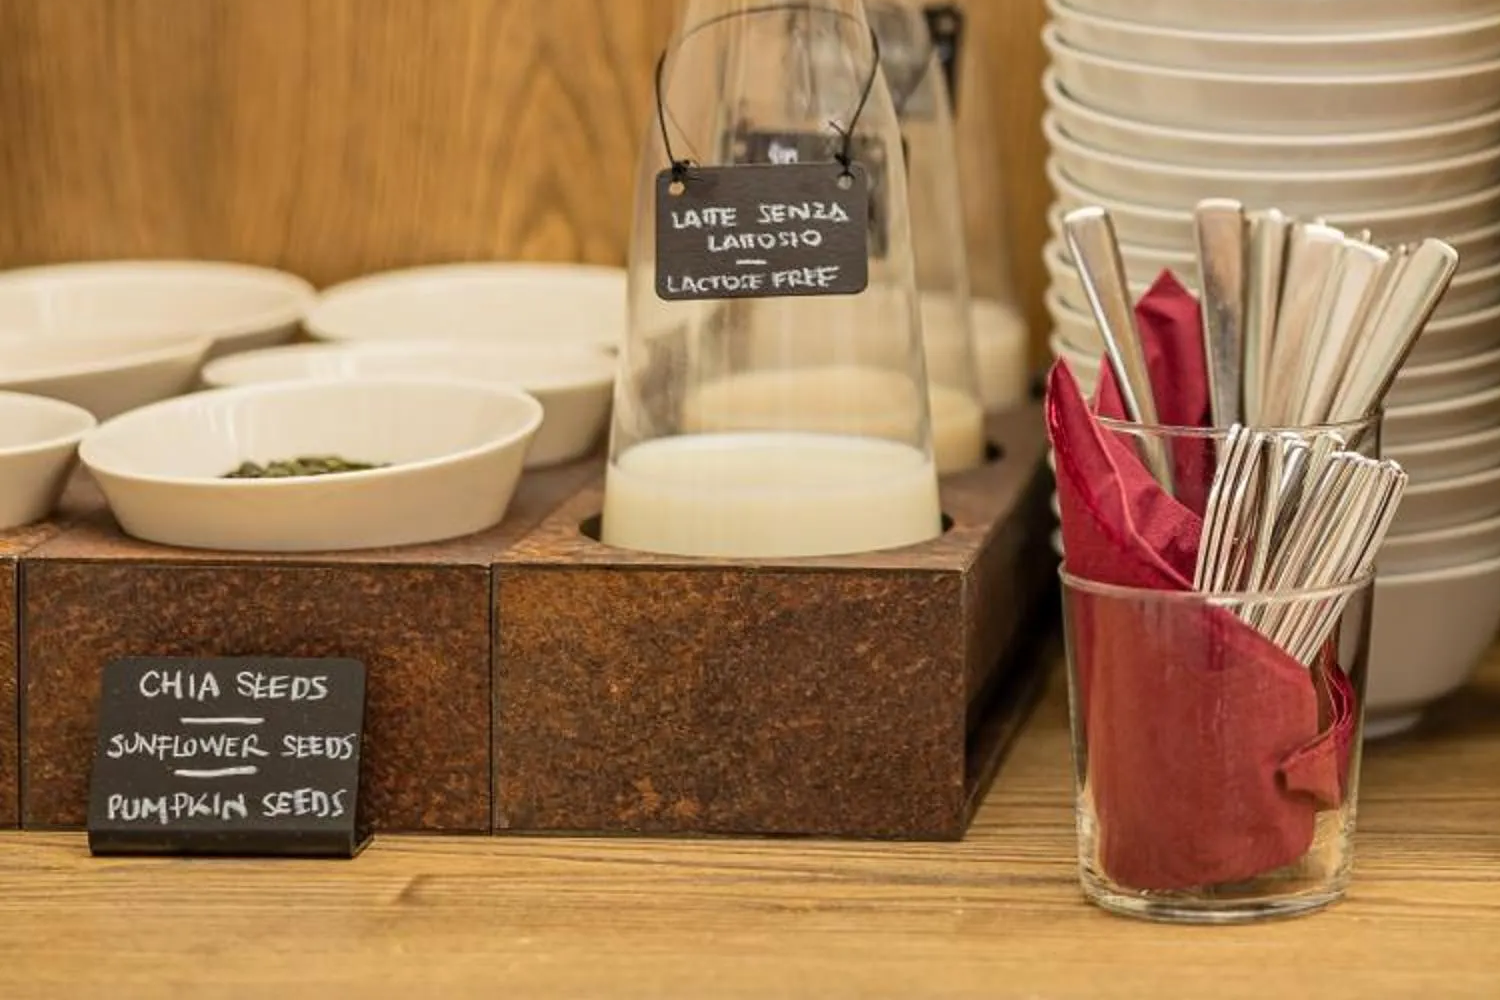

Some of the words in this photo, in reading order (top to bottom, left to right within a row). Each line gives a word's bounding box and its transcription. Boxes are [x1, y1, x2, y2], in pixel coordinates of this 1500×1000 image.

[756, 202, 849, 223] SENZA
[667, 274, 764, 293] LACTOSE
[772, 265, 840, 288] FREE
[139, 670, 220, 701] CHIA
[236, 671, 328, 700] SEEDS
[107, 732, 270, 760] SUNFLOWER
[280, 733, 356, 759] SEEDS
[107, 792, 248, 825] PUMPKIN
[262, 788, 347, 817] SEEDS
